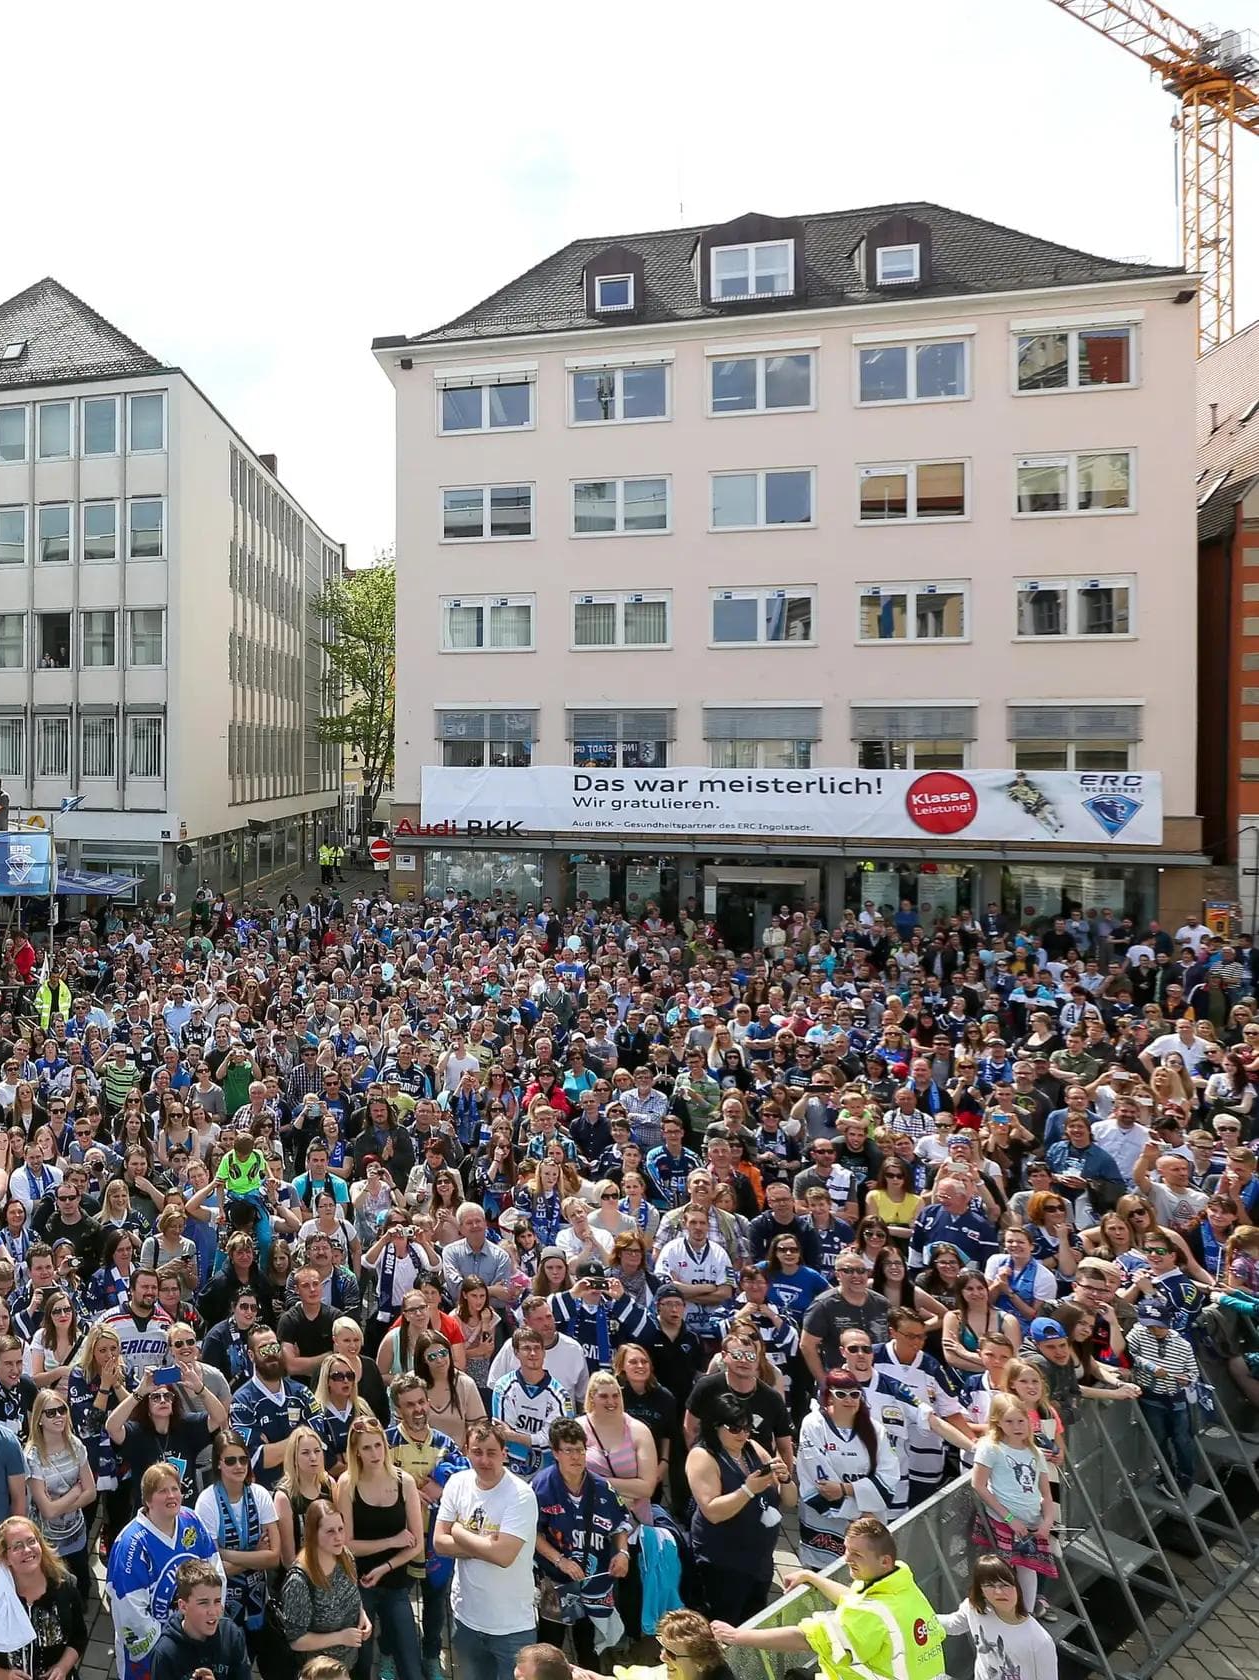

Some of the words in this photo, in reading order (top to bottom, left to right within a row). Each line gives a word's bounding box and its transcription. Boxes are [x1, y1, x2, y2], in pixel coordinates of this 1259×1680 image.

[574, 774, 625, 792] Das
[633, 778, 689, 792] war
[699, 775, 883, 795] meisterlich!
[1079, 774, 1143, 786] ERC
[1080, 786, 1142, 794] INGOLSTADT
[572, 796, 605, 808] Wir
[611, 797, 720, 811] gratulieren.
[911, 791, 971, 806] Klasse
[914, 802, 972, 817] Leistung!
[396, 818, 457, 837] Audi
[466, 819, 526, 838] BKK
[623, 820, 717, 830] Gesundheitspartner
[718, 822, 736, 830] des
[758, 823, 813, 831] Ingolstadt.
